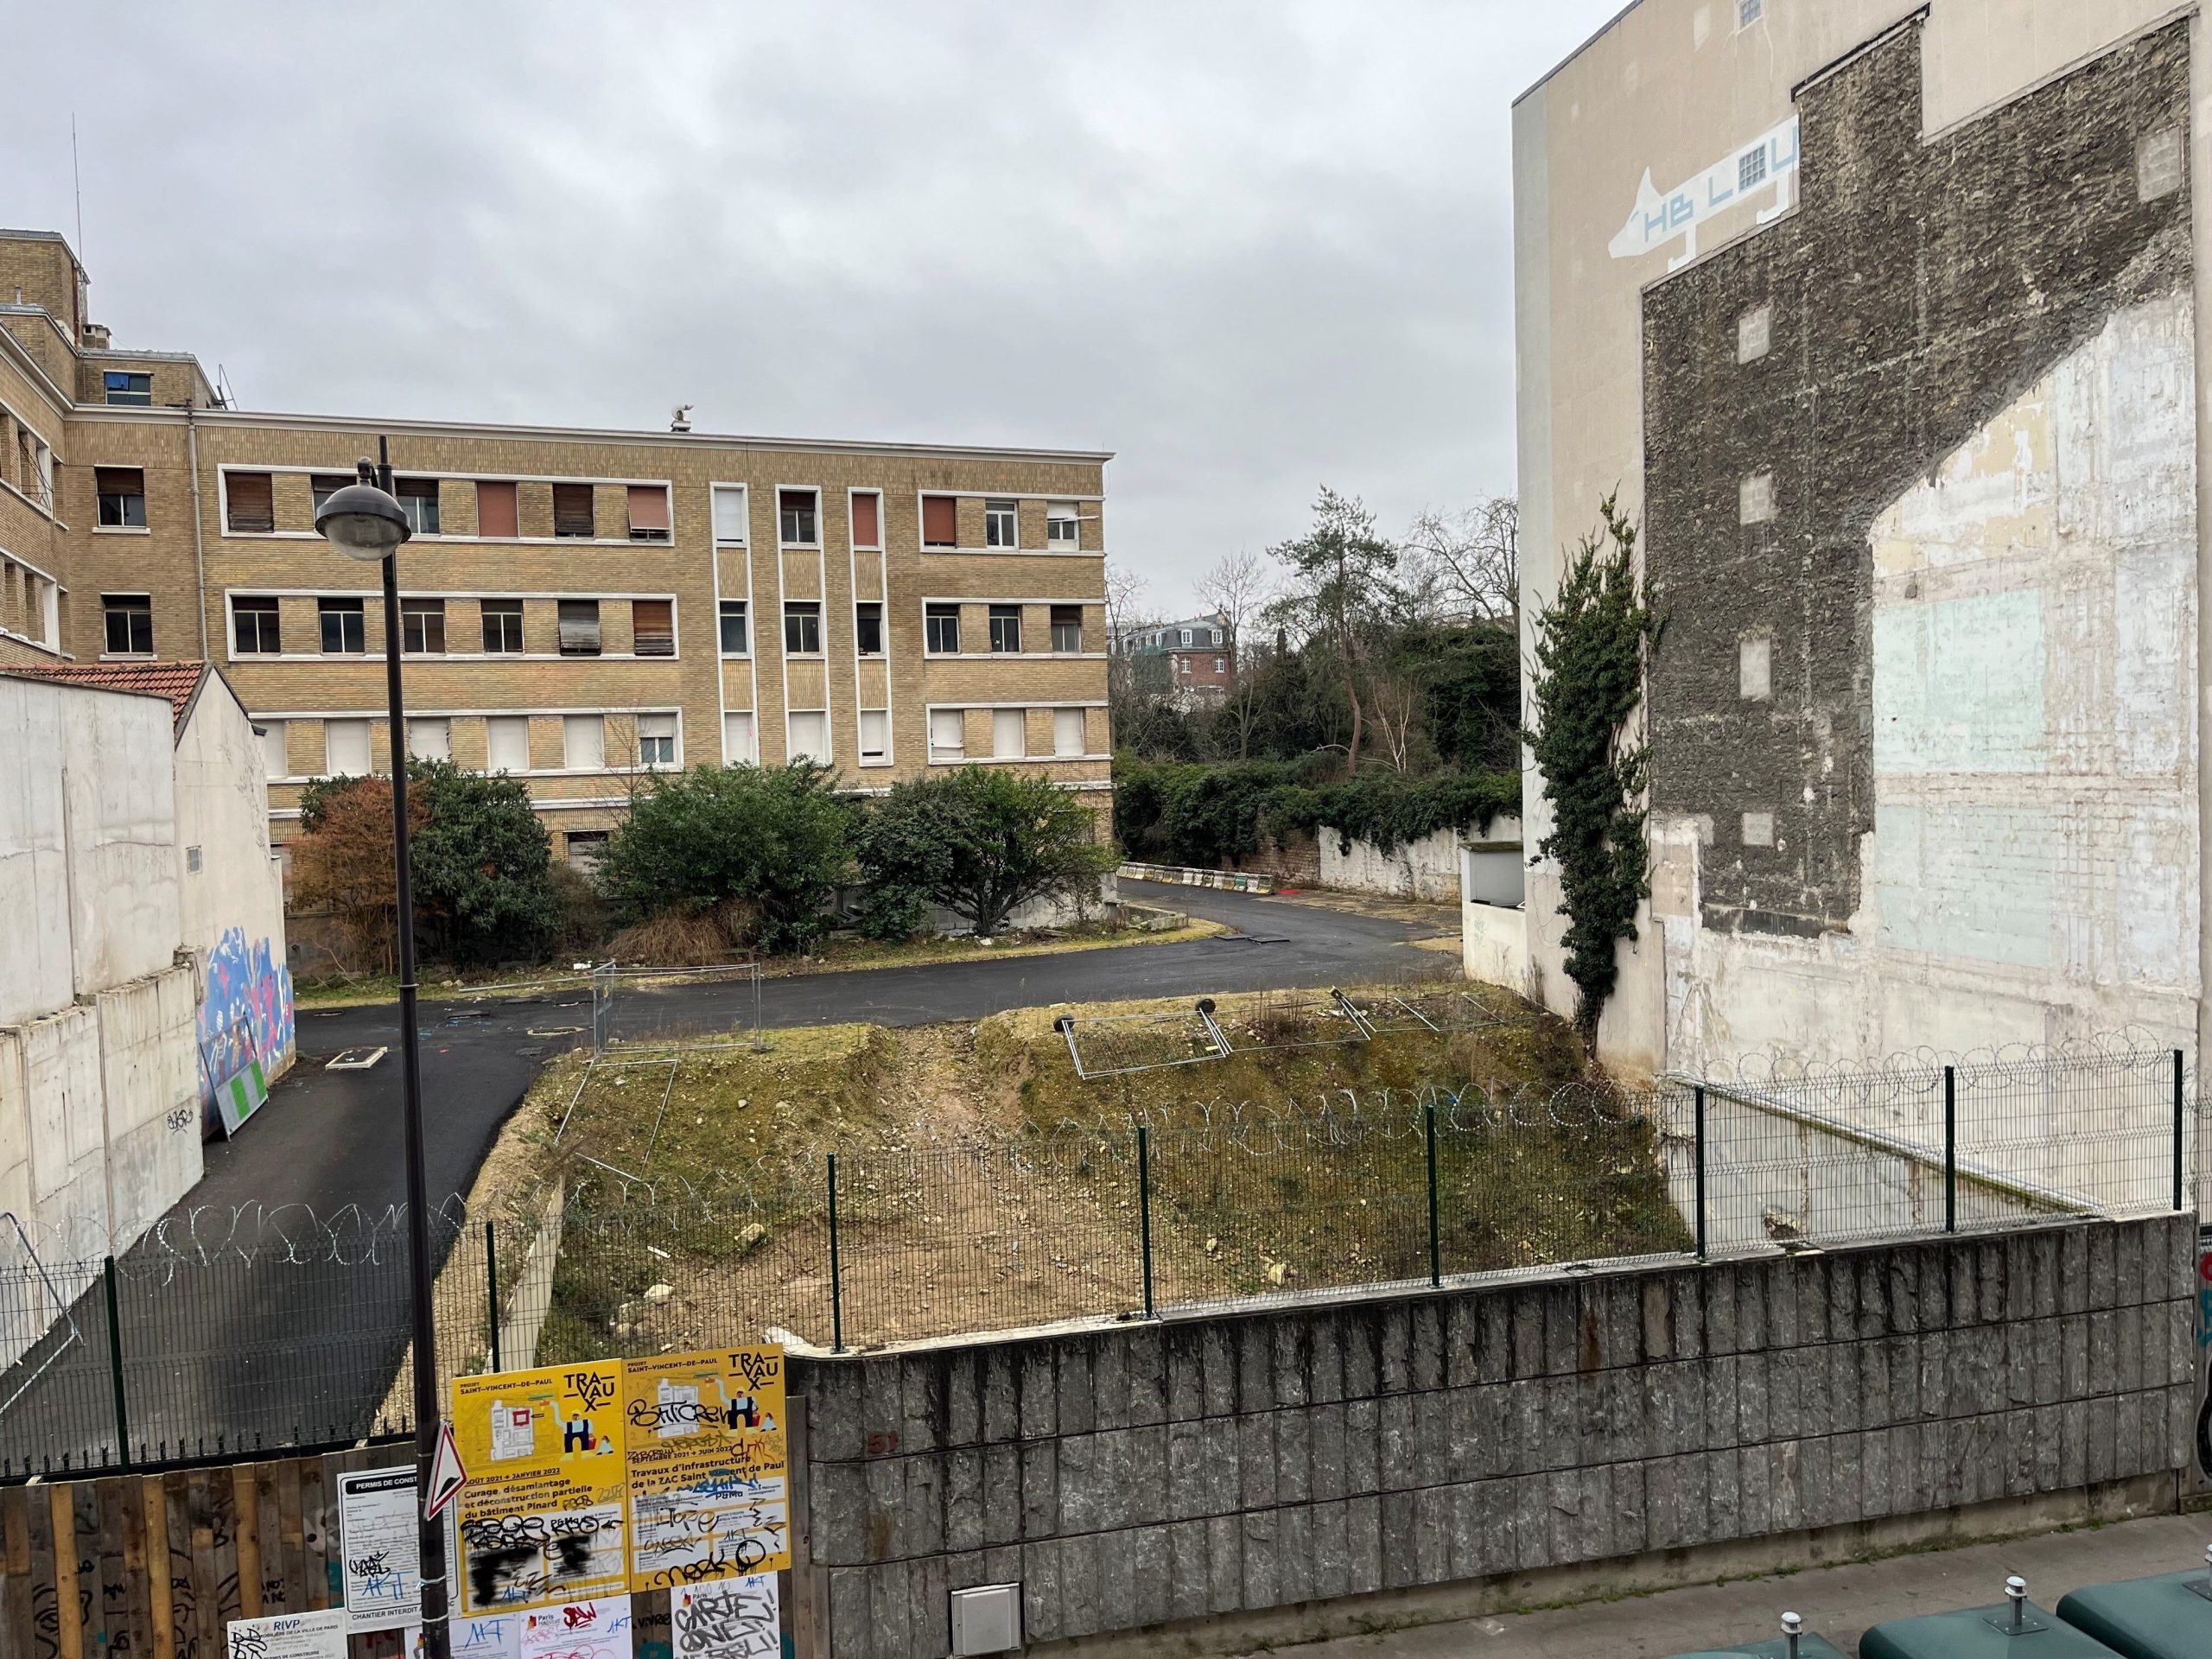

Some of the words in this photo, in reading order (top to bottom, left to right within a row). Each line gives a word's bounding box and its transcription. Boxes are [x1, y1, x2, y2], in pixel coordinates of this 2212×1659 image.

[631, 1466, 670, 1478] Travaux
[672, 1455, 751, 1472] d'infrastructure
[632, 1480, 645, 1489] de
[658, 1476, 678, 1484] ZAC
[681, 1471, 707, 1483] Saint
[748, 1464, 761, 1473] de
[764, 1460, 785, 1471] Paul
[356, 1480, 382, 1490] PERMIS
[467, 1477, 484, 1485] OÛT
[512, 1469, 542, 1480] JANVIER
[504, 1478, 571, 1493] désamiantage
[477, 1491, 550, 1508] déconstruction
[552, 1484, 593, 1499] partielle
[465, 1510, 478, 1520] du
[480, 1503, 524, 1517] bâtiment
[527, 1499, 557, 1510] Pinard
[352, 1610, 386, 1620] CHANTIER
[387, 1606, 417, 1617] INTERDIT
[273, 1619, 301, 1631] RIVP
